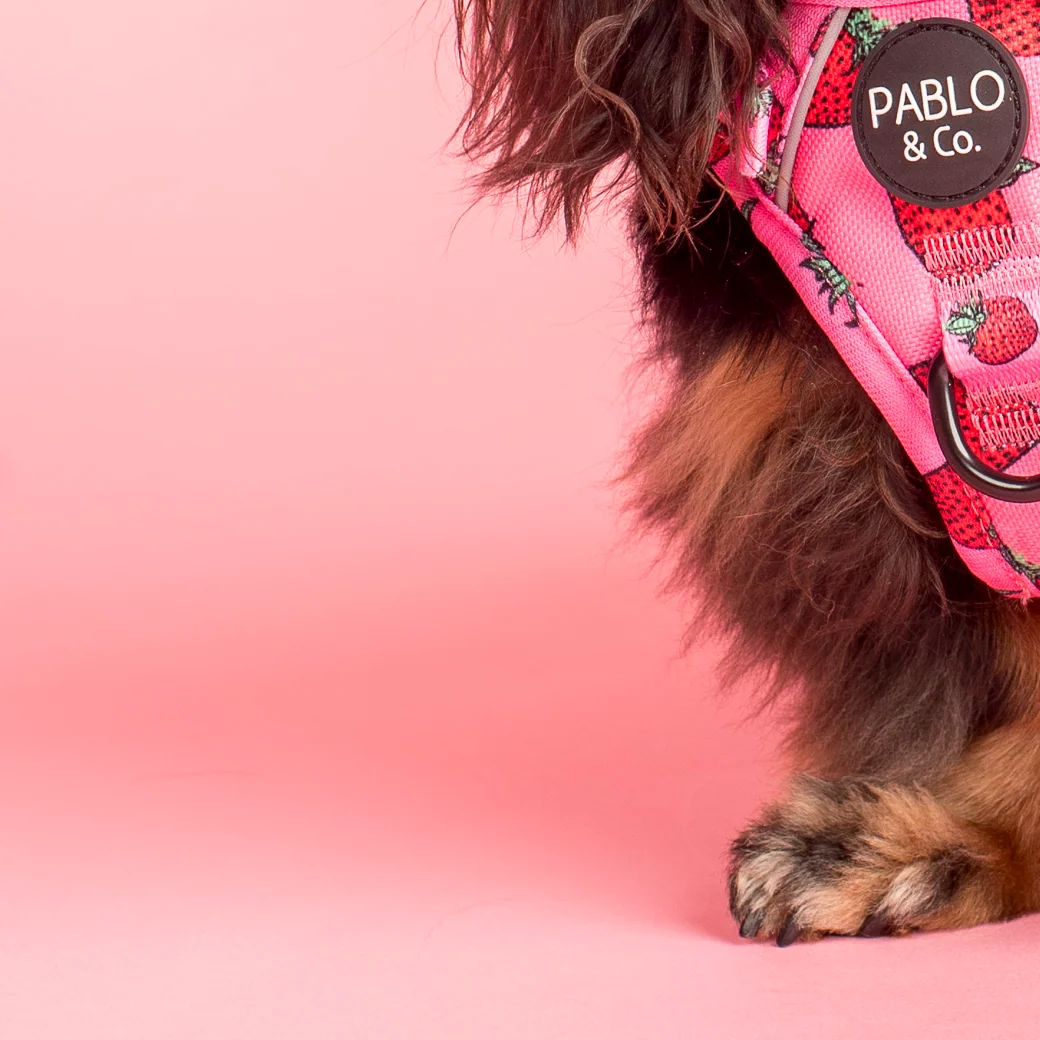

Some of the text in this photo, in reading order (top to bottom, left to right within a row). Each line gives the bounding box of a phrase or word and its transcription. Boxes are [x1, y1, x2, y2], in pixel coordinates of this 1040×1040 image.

[868, 69, 1006, 129] PABLO
[903, 125, 982, 162] & Co.
